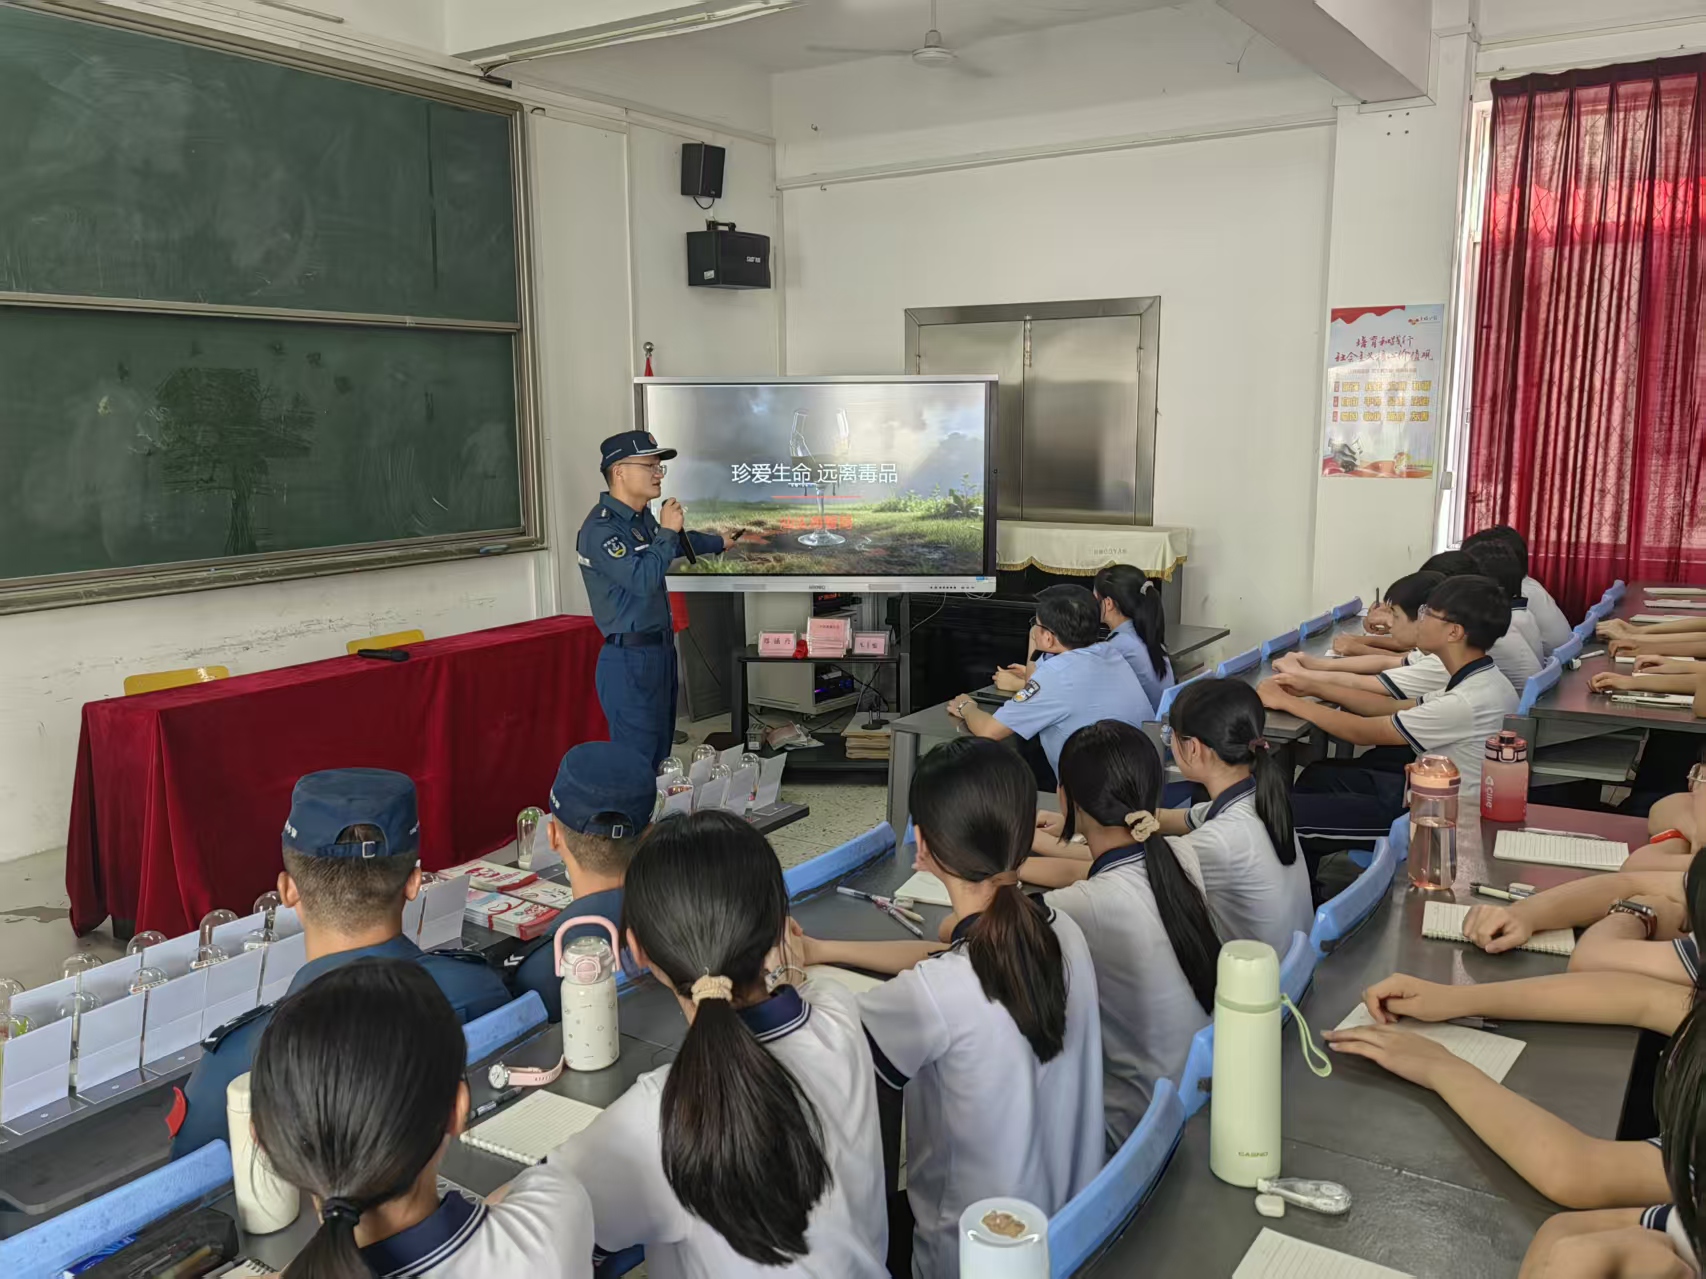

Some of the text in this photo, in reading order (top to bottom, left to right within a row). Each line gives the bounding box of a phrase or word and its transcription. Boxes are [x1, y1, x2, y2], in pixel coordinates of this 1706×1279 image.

[1356, 335, 1413, 348] 培育和践行
[731, 463, 897, 483] 珍爱生命 远离毒品
